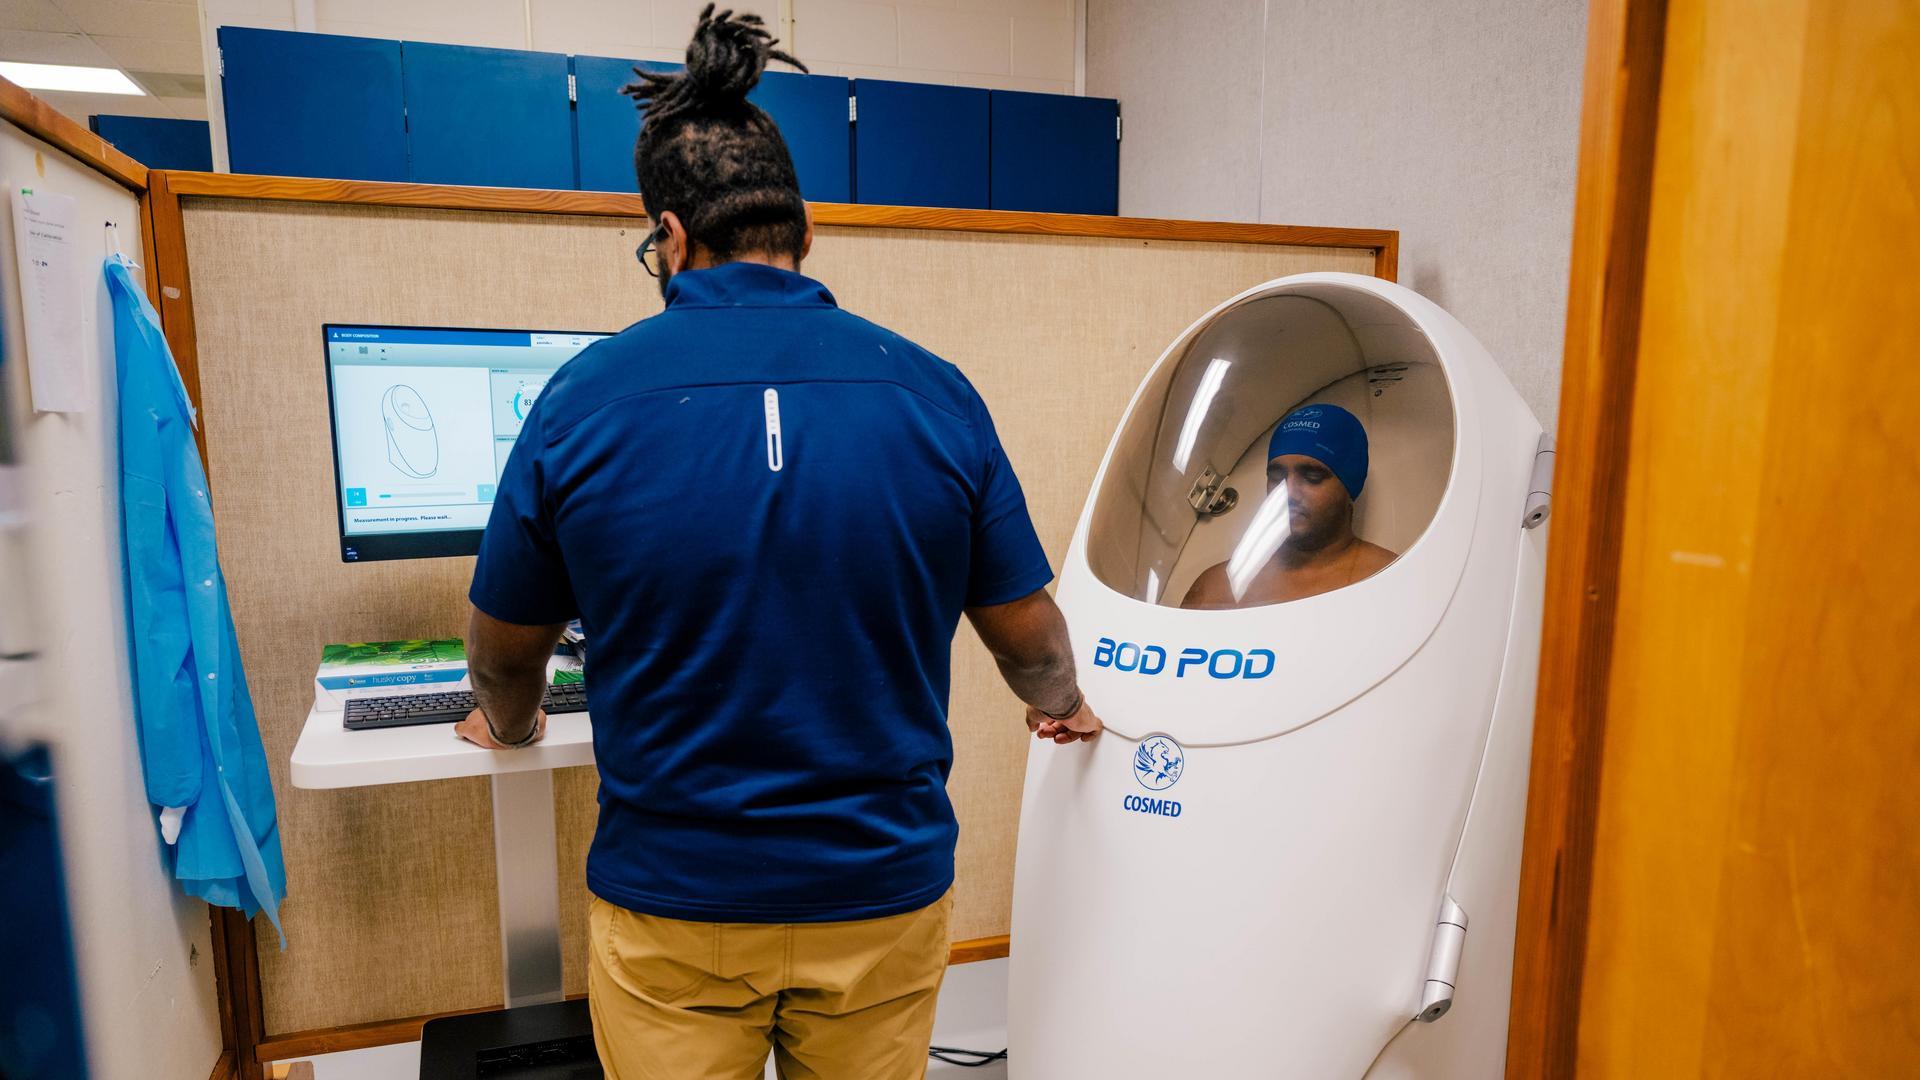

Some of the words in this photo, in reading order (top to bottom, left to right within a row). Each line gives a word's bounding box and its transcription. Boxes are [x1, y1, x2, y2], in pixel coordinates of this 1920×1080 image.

[1283, 420, 1321, 429] COSMED
[1093, 637, 1167, 676] BOD
[1176, 648, 1276, 680] POD
[372, 675, 396, 683] husky
[396, 674, 417, 683] copy
[1123, 794, 1182, 818] COSMED
